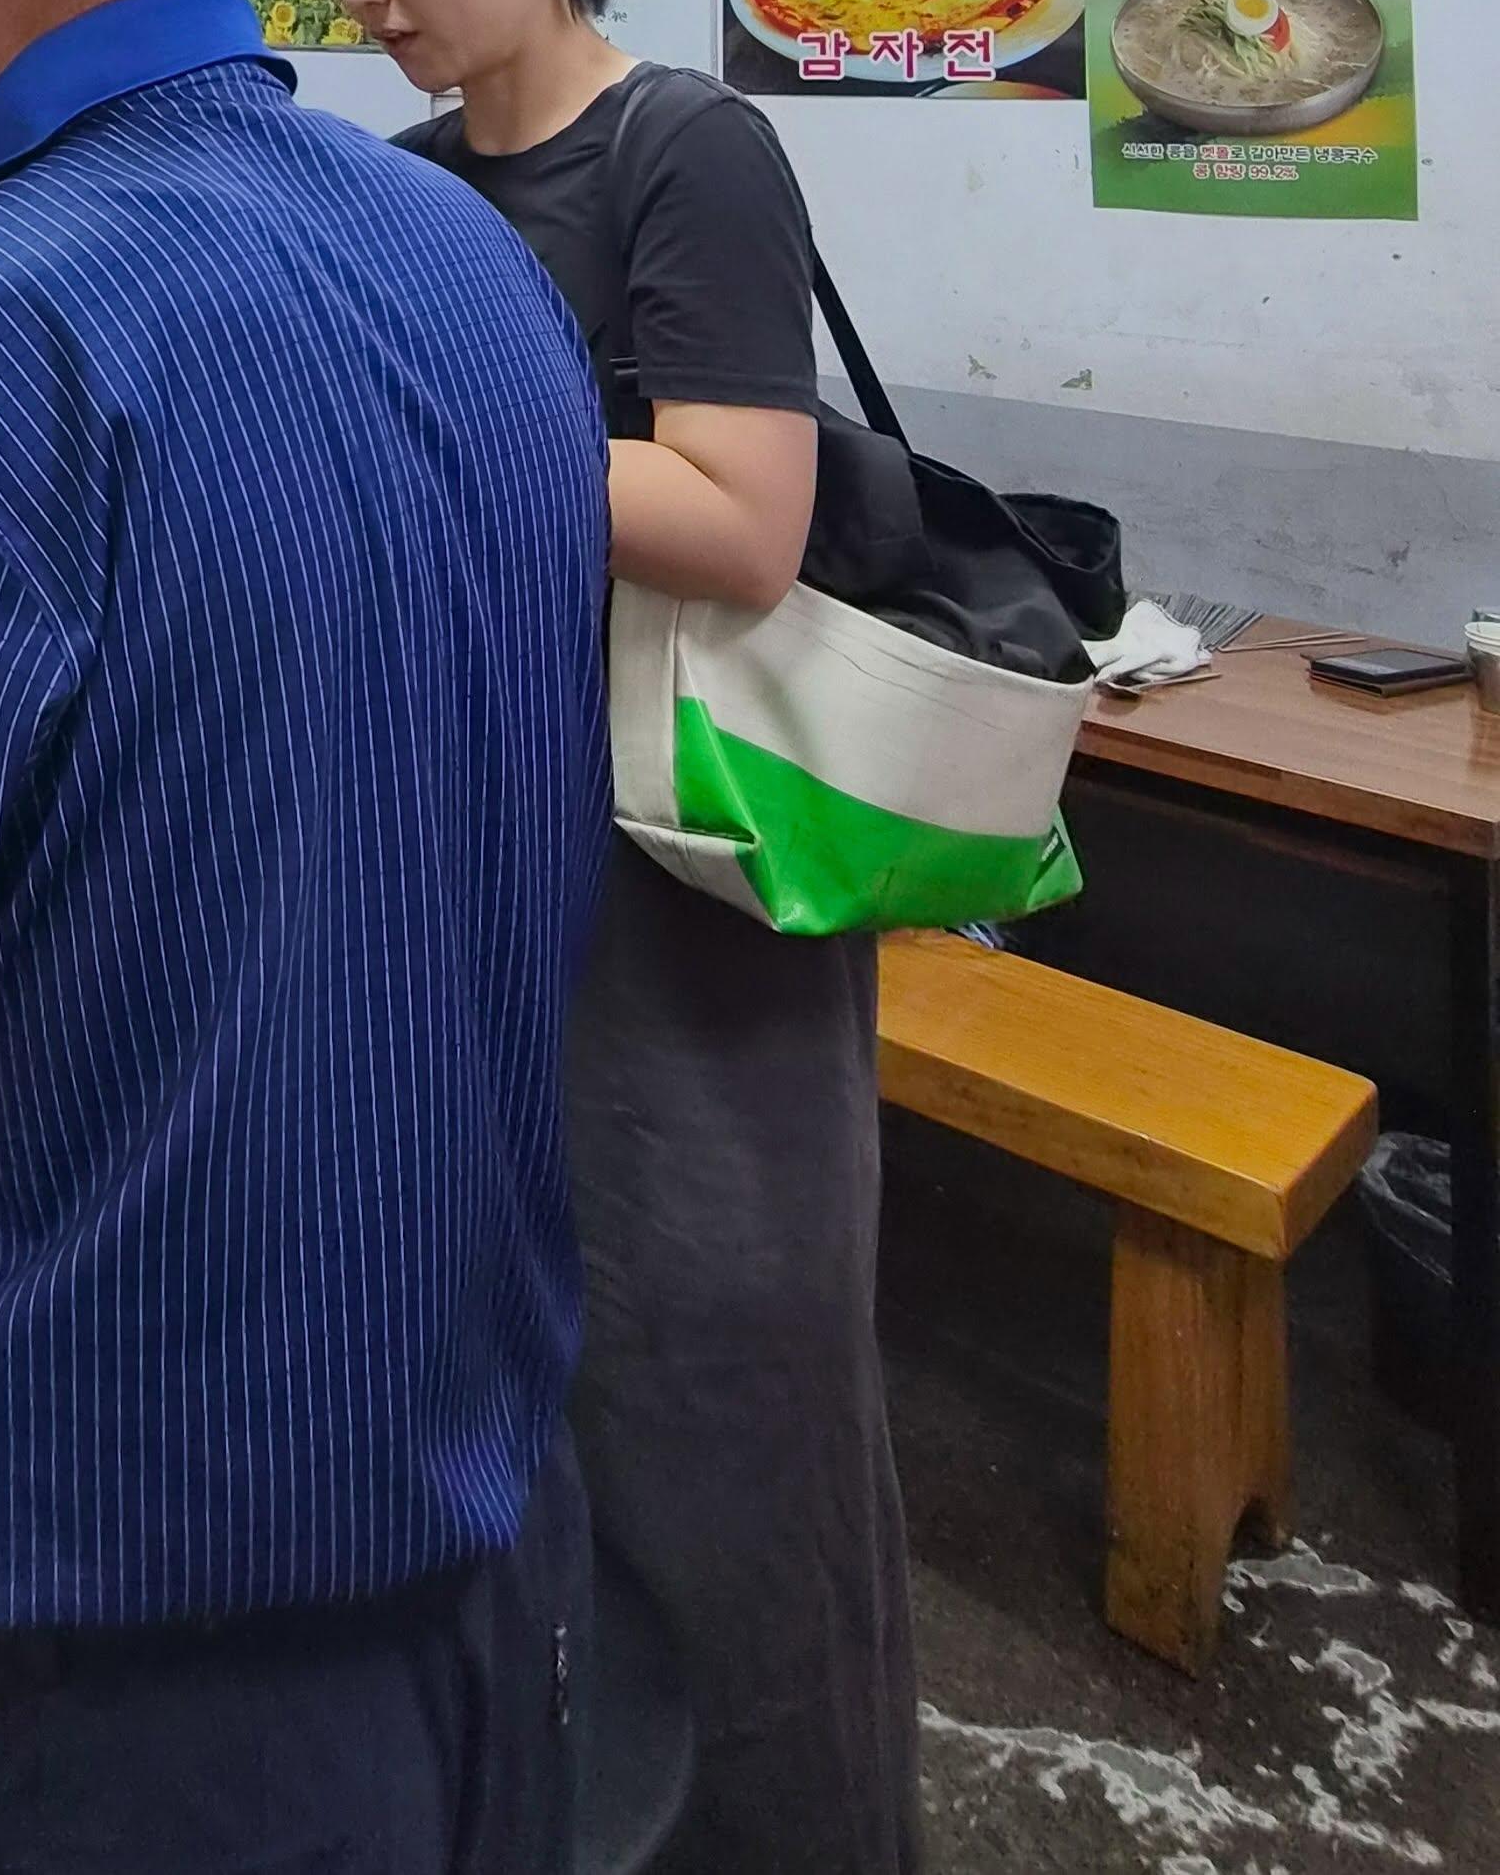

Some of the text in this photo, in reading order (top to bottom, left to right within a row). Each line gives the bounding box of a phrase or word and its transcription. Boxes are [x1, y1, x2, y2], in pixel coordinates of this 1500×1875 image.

[796, 26, 997, 82] 감자전
[1122, 143, 1164, 160] 신선한
[1250, 145, 1311, 162] 갈아만든
[1314, 147, 1379, 165] 냉콩국수
[1249, 165, 1299, 181] 99.2%
